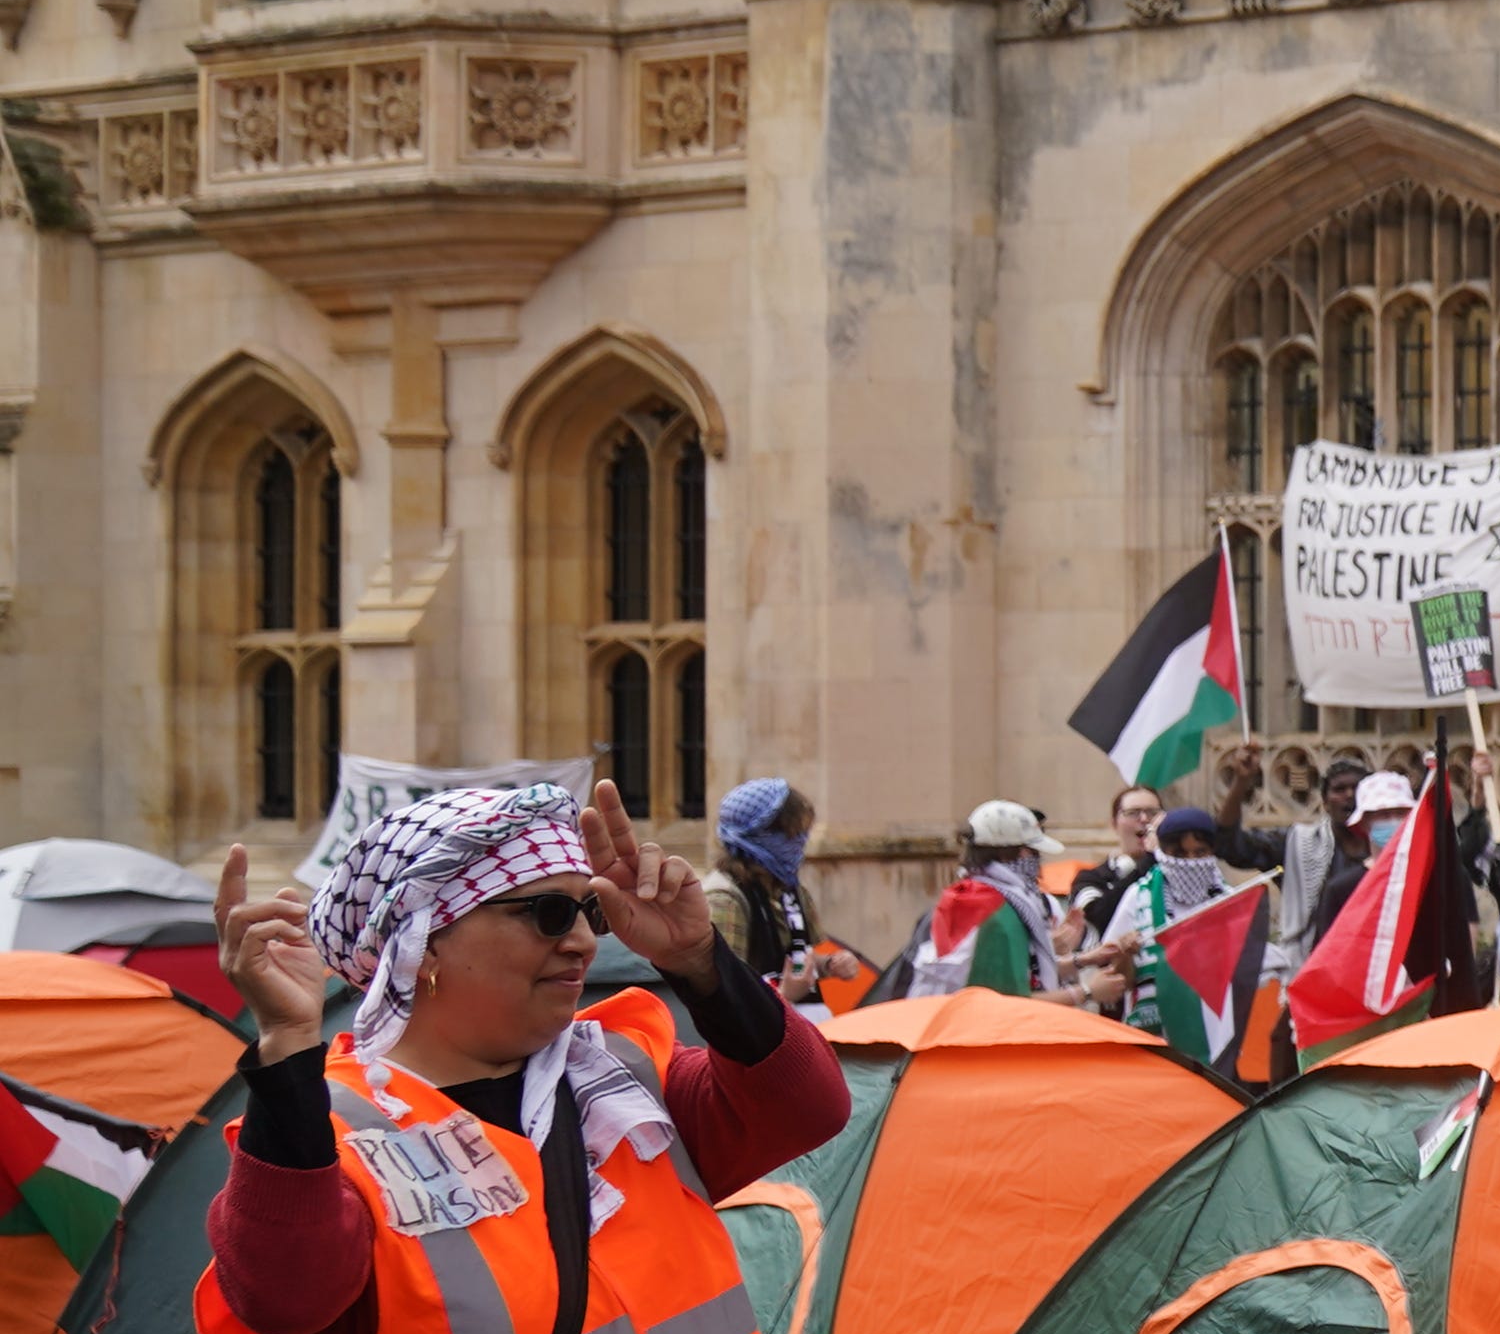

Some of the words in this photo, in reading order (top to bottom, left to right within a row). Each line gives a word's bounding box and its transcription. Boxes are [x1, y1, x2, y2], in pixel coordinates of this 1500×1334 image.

[1297, 498, 1327, 533] FOR
[1331, 500, 1439, 538] JUSTICE
[1450, 499, 1483, 534] IN
[1432, 674, 1467, 697] FREE
[346, 1120, 495, 1182] POLICE
[386, 1175, 521, 1227] LIASON
